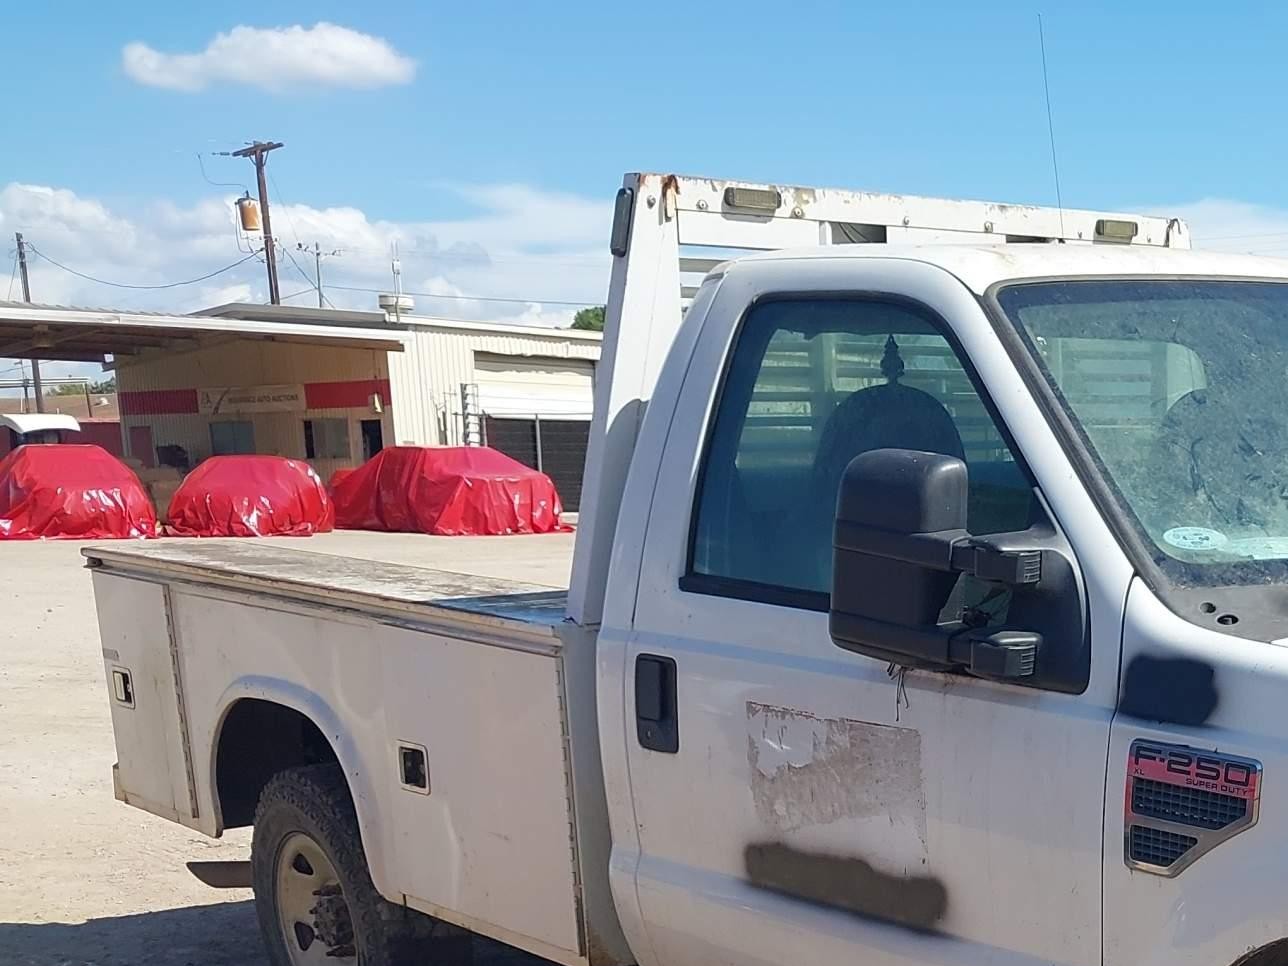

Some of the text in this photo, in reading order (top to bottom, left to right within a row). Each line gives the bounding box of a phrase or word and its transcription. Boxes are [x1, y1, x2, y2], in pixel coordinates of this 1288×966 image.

[1134, 768, 1145, 776] XL
[1135, 745, 1250, 786] F-250
[1186, 778, 1249, 796] SUPER DUTY
